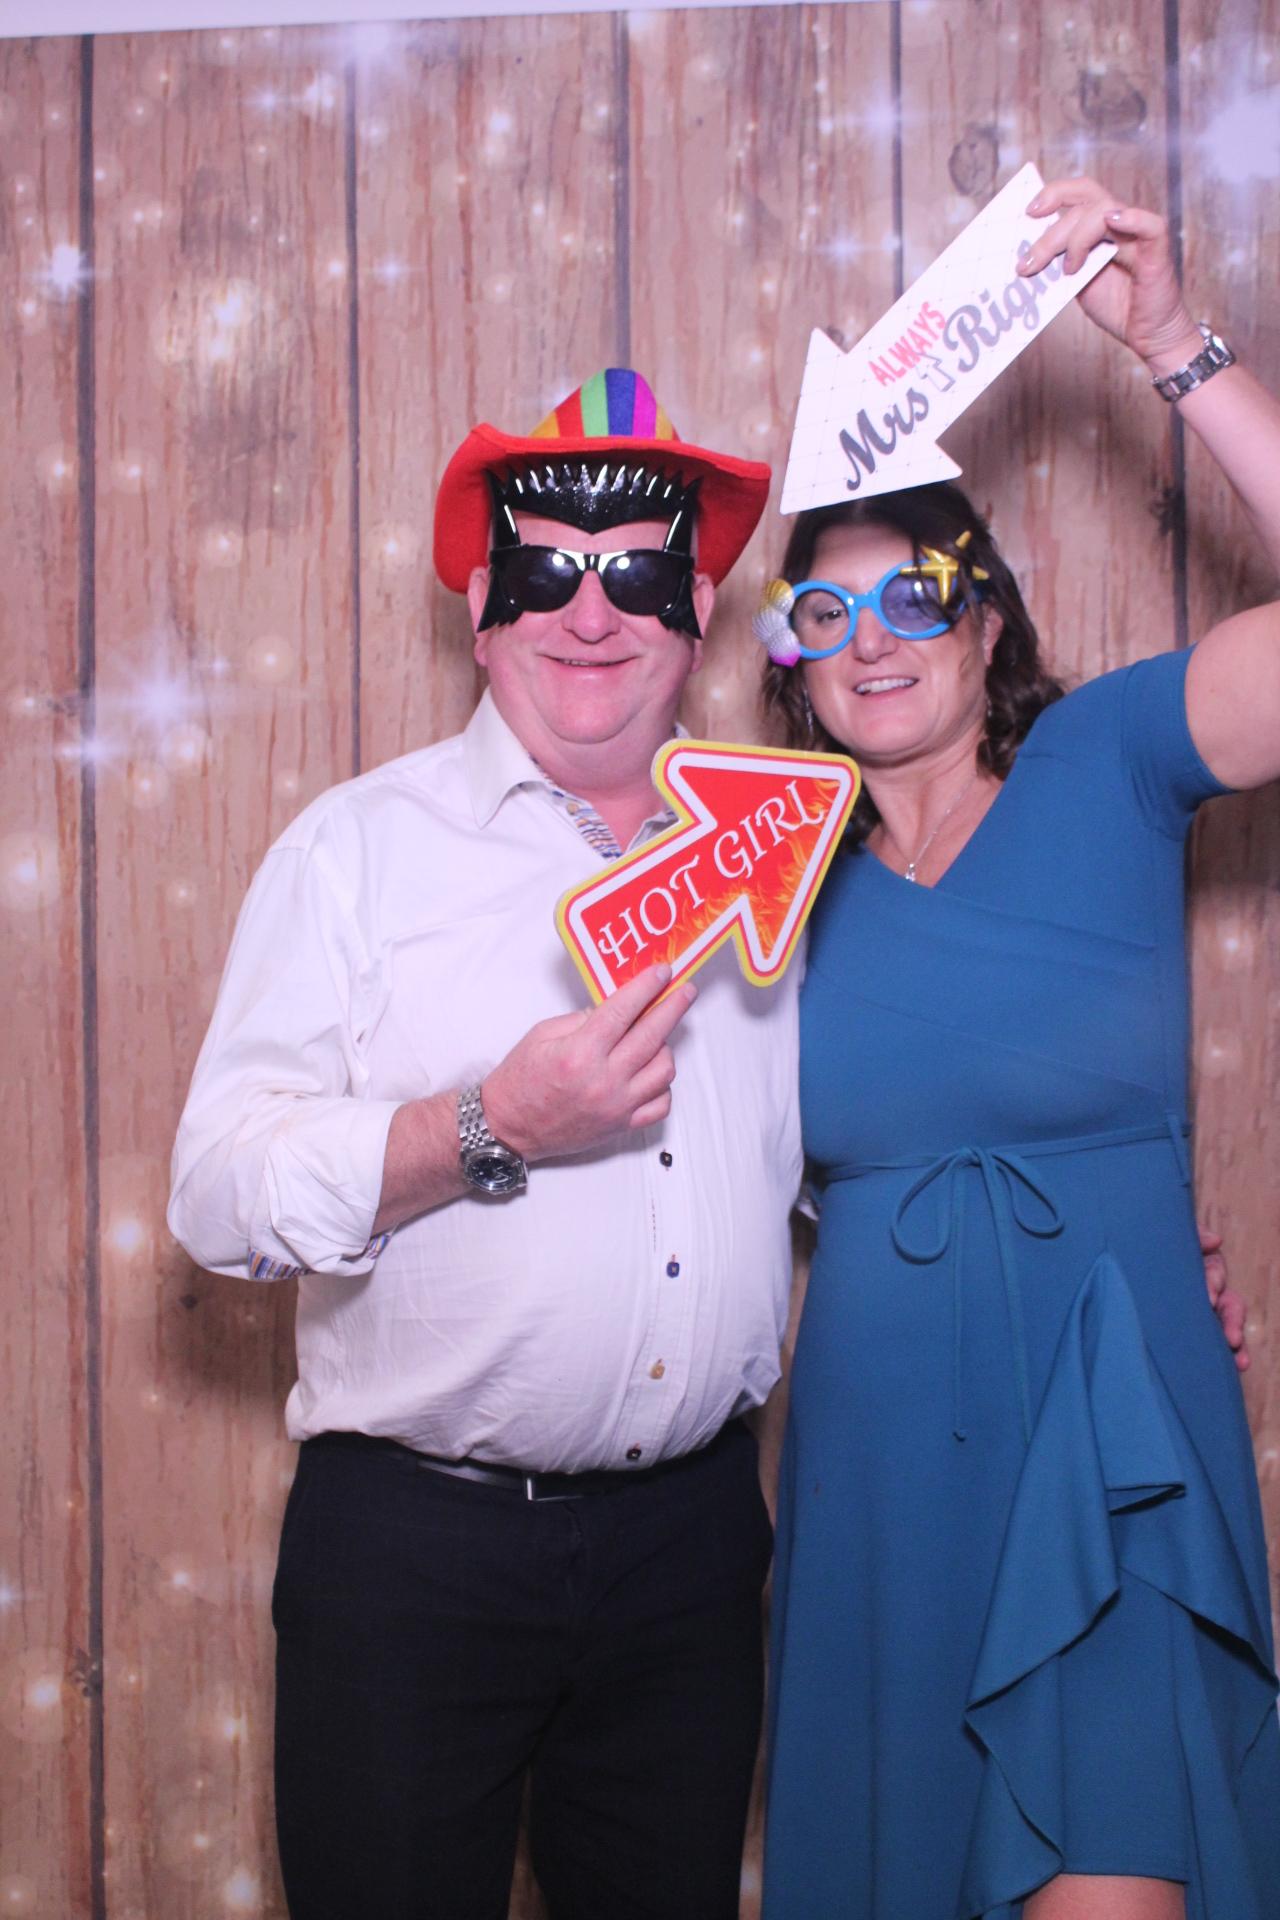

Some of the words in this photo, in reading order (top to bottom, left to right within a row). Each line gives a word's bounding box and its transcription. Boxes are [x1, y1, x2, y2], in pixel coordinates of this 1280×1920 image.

[868, 302, 946, 387] ALWAYS
[839, 387, 929, 491] Mrs
[598, 855, 705, 968] HOT
[713, 780, 824, 879] GIRL
